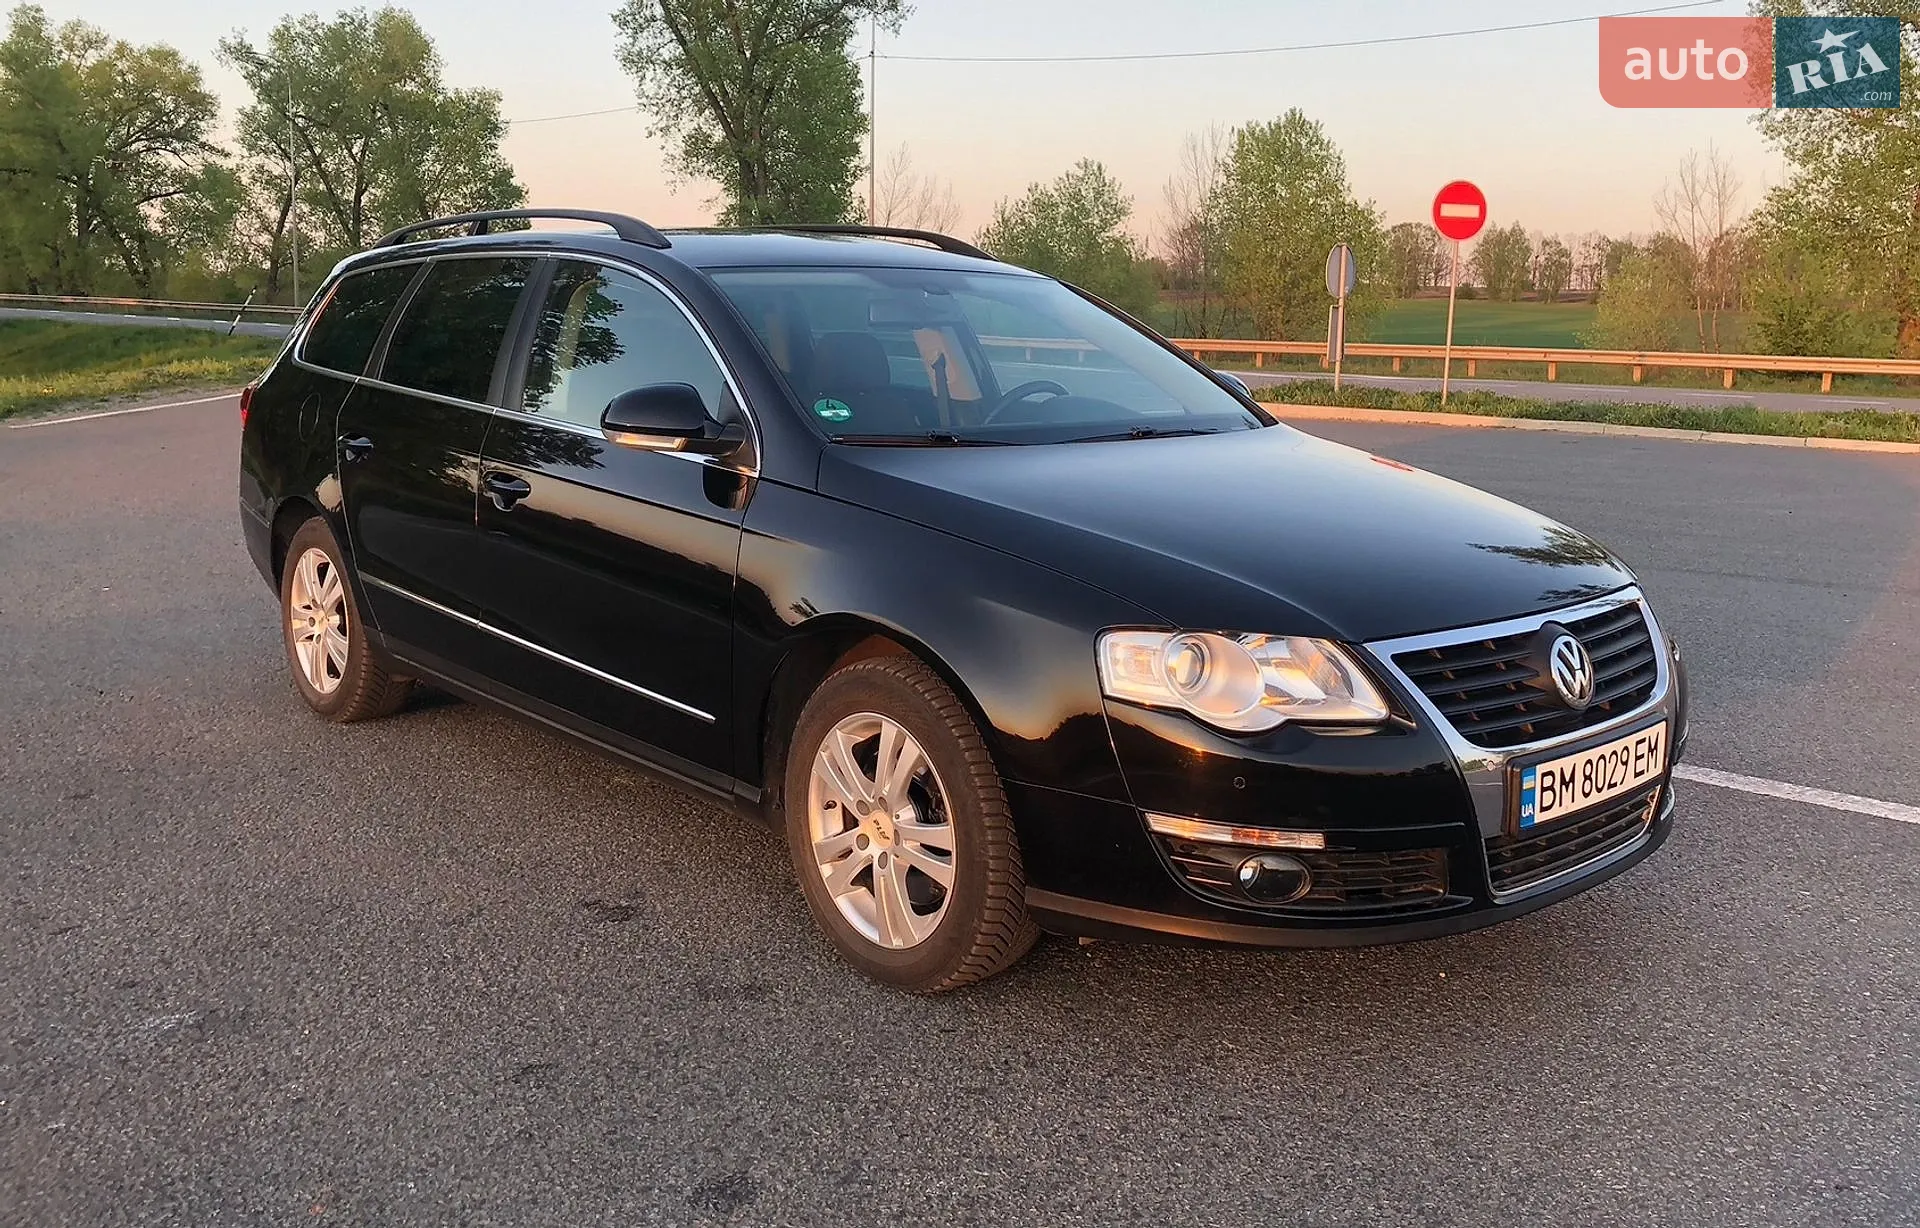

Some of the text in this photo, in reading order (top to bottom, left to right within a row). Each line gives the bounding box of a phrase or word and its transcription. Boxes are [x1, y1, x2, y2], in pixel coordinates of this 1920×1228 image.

[1554, 637, 1592, 703] VW
[1539, 731, 1660, 813] BM 8029 EM
[1521, 803, 1534, 817] UA
